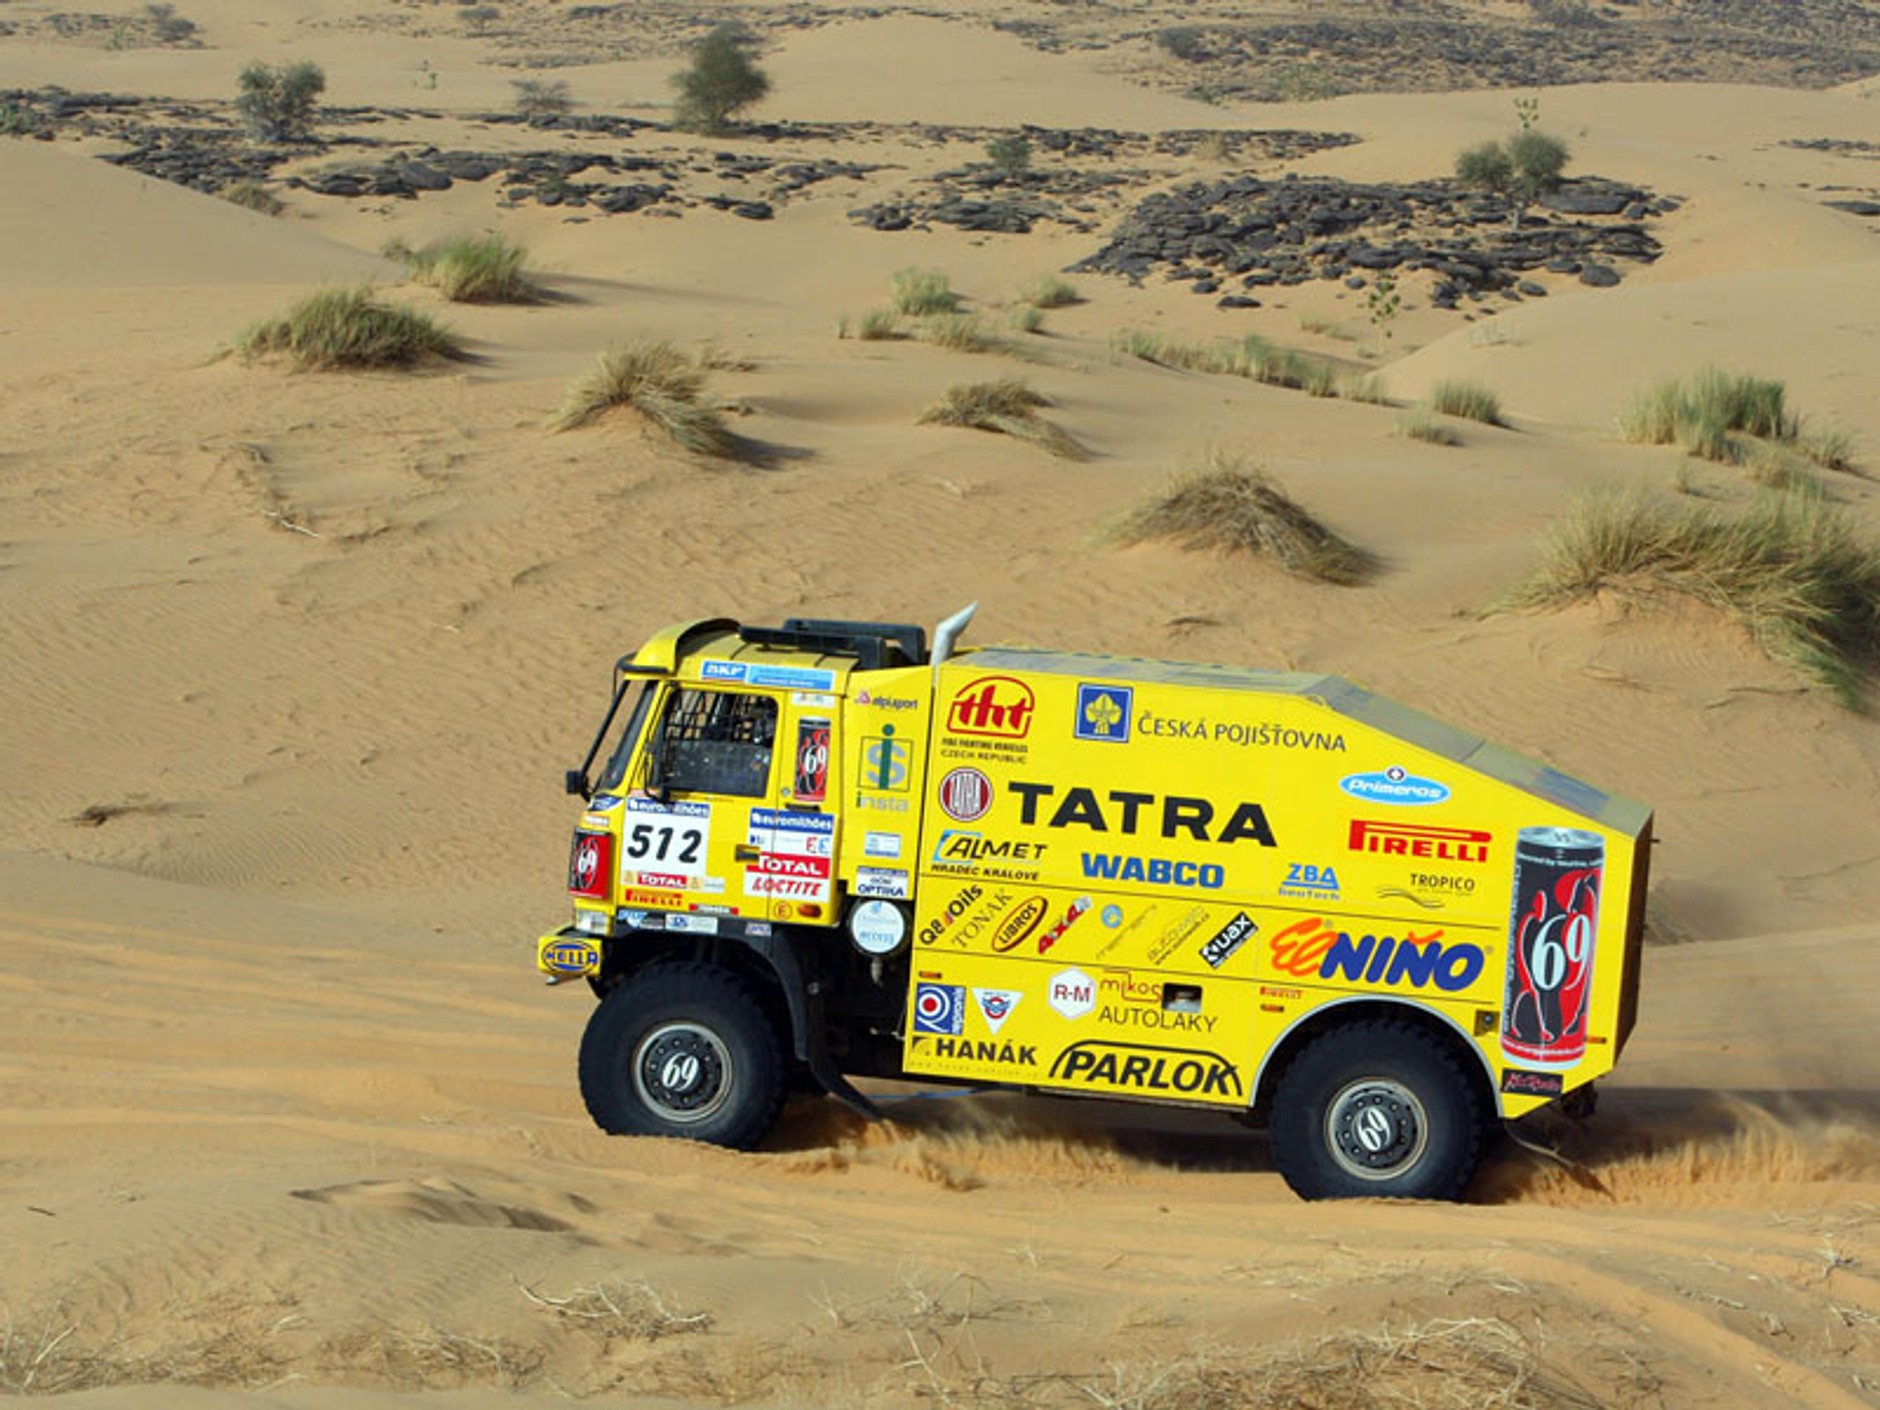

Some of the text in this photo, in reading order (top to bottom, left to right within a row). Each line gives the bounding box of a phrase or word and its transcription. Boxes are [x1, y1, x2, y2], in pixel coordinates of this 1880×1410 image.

[1138, 710, 1346, 752] ČESKÁ POJIŠŤOVNA
[1009, 781, 1277, 848] TATRA
[627, 824, 702, 864] 512
[945, 836, 1048, 860] ALMET
[1349, 819, 1491, 863] PIRELLI
[640, 874, 686, 888] TOTAL
[758, 855, 823, 876] TOTAL
[931, 863, 980, 876] HRADEC
[1081, 853, 1224, 889] WABCO
[1287, 863, 1339, 887] ZBA
[752, 877, 823, 897] LOCTITE
[858, 884, 904, 897] OPTIKA
[1411, 874, 1475, 891] TROPICO
[919, 919, 946, 945] Q8
[948, 884, 984, 917] Oils
[999, 904, 1039, 944] LIBROS
[1531, 913, 1591, 991] 69
[1054, 984, 1091, 1003] R-M
[1099, 1006, 1218, 1033] AUTOLAKY
[936, 1038, 1038, 1066] HANÁK
[662, 1052, 700, 1092] 69
[1062, 1049, 1238, 1096] PARLOK
[1355, 1106, 1391, 1151] 69
